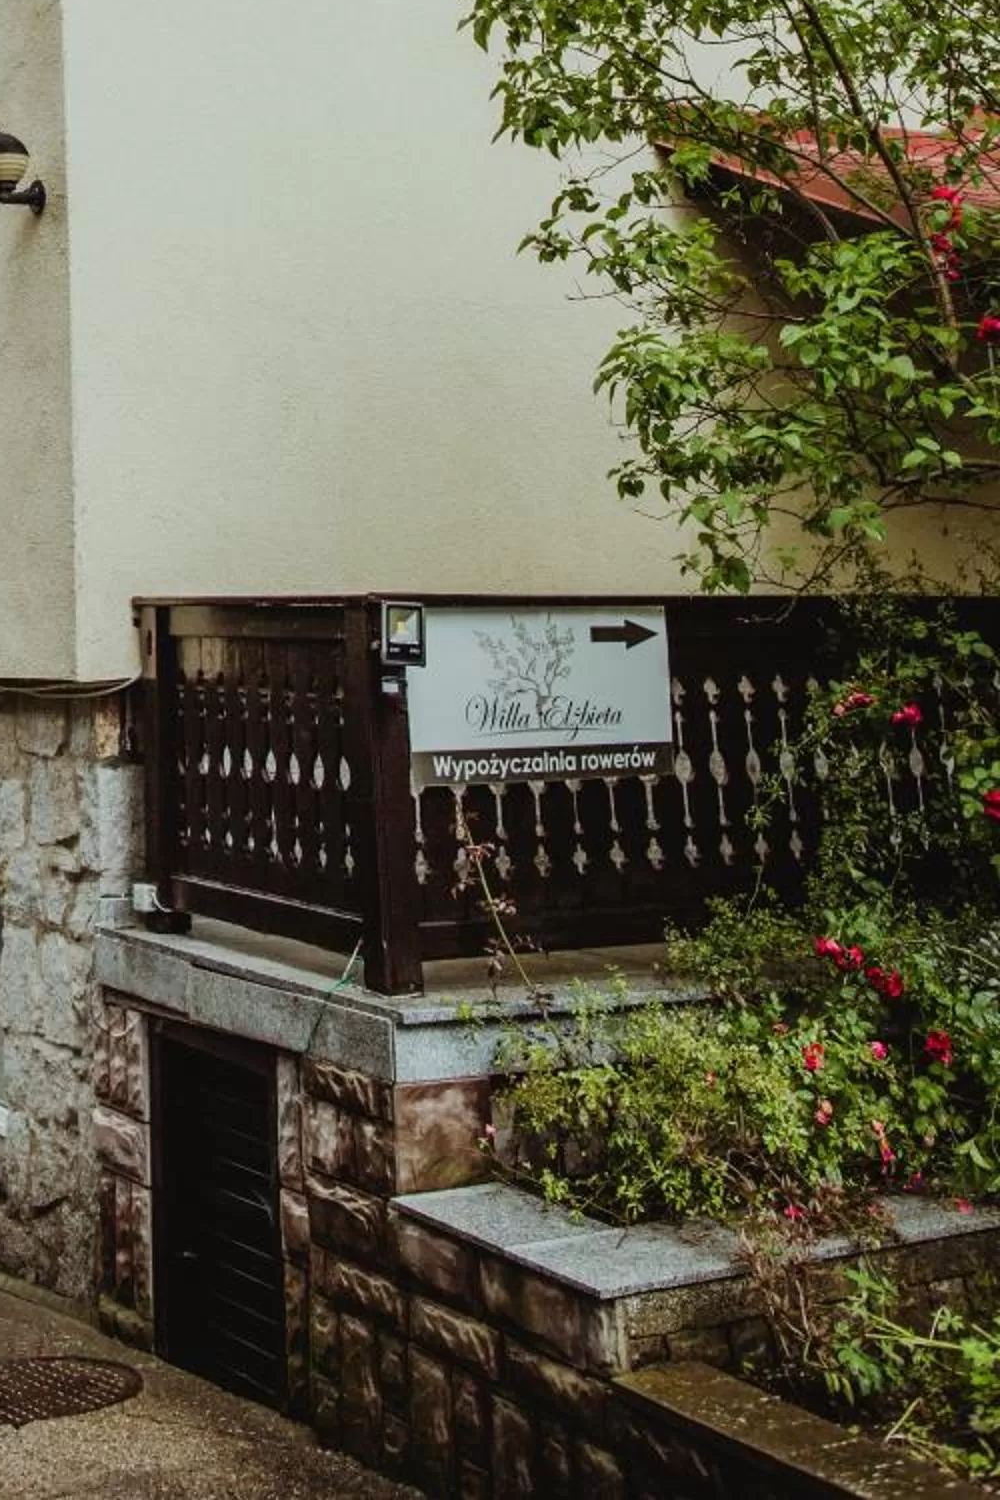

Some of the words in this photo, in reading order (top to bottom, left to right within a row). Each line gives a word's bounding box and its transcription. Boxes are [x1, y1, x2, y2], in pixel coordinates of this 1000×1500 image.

[465, 695, 530, 732] Willa
[543, 696, 624, 740] Elżbieta
[433, 752, 577, 780] Wypożyczalnia
[581, 746, 656, 769] rowerów
